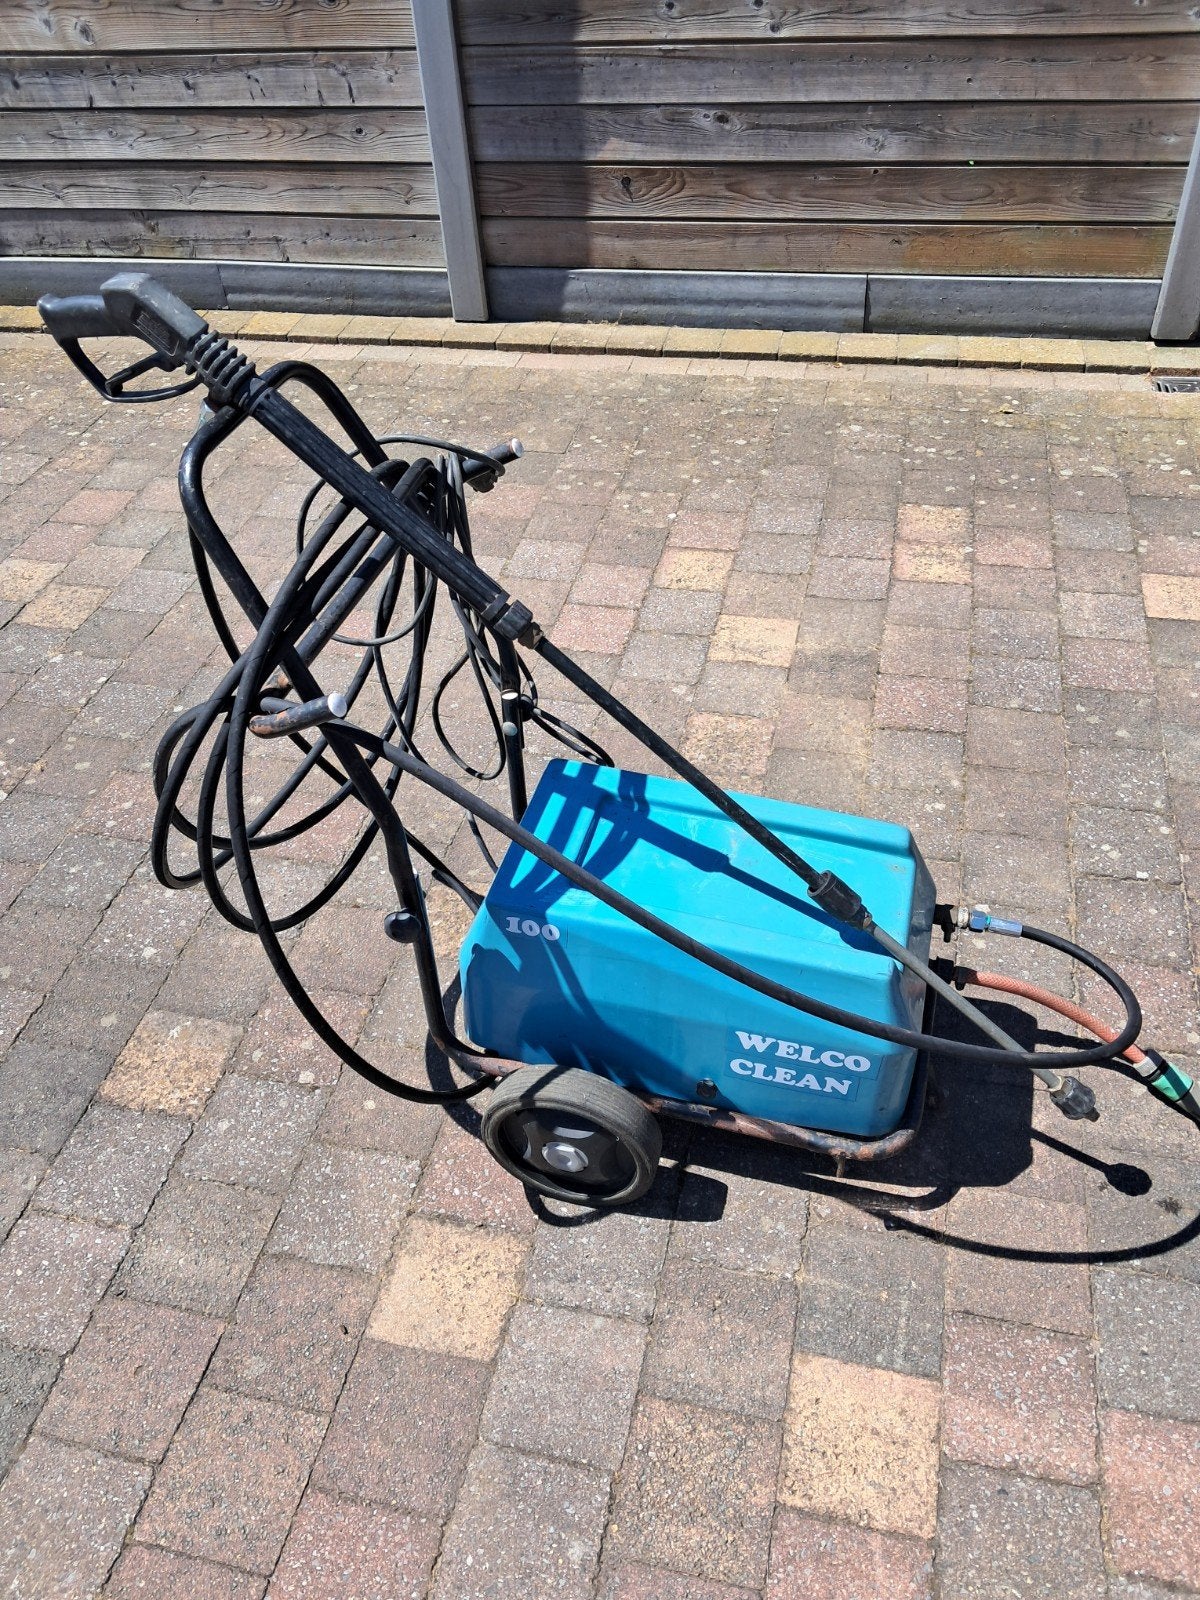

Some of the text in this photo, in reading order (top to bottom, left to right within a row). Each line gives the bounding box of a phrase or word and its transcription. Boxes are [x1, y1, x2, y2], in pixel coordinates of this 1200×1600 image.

[506, 916, 560, 941] 100
[735, 1031, 871, 1072] WELCO
[730, 1058, 852, 1095] CLEAN
